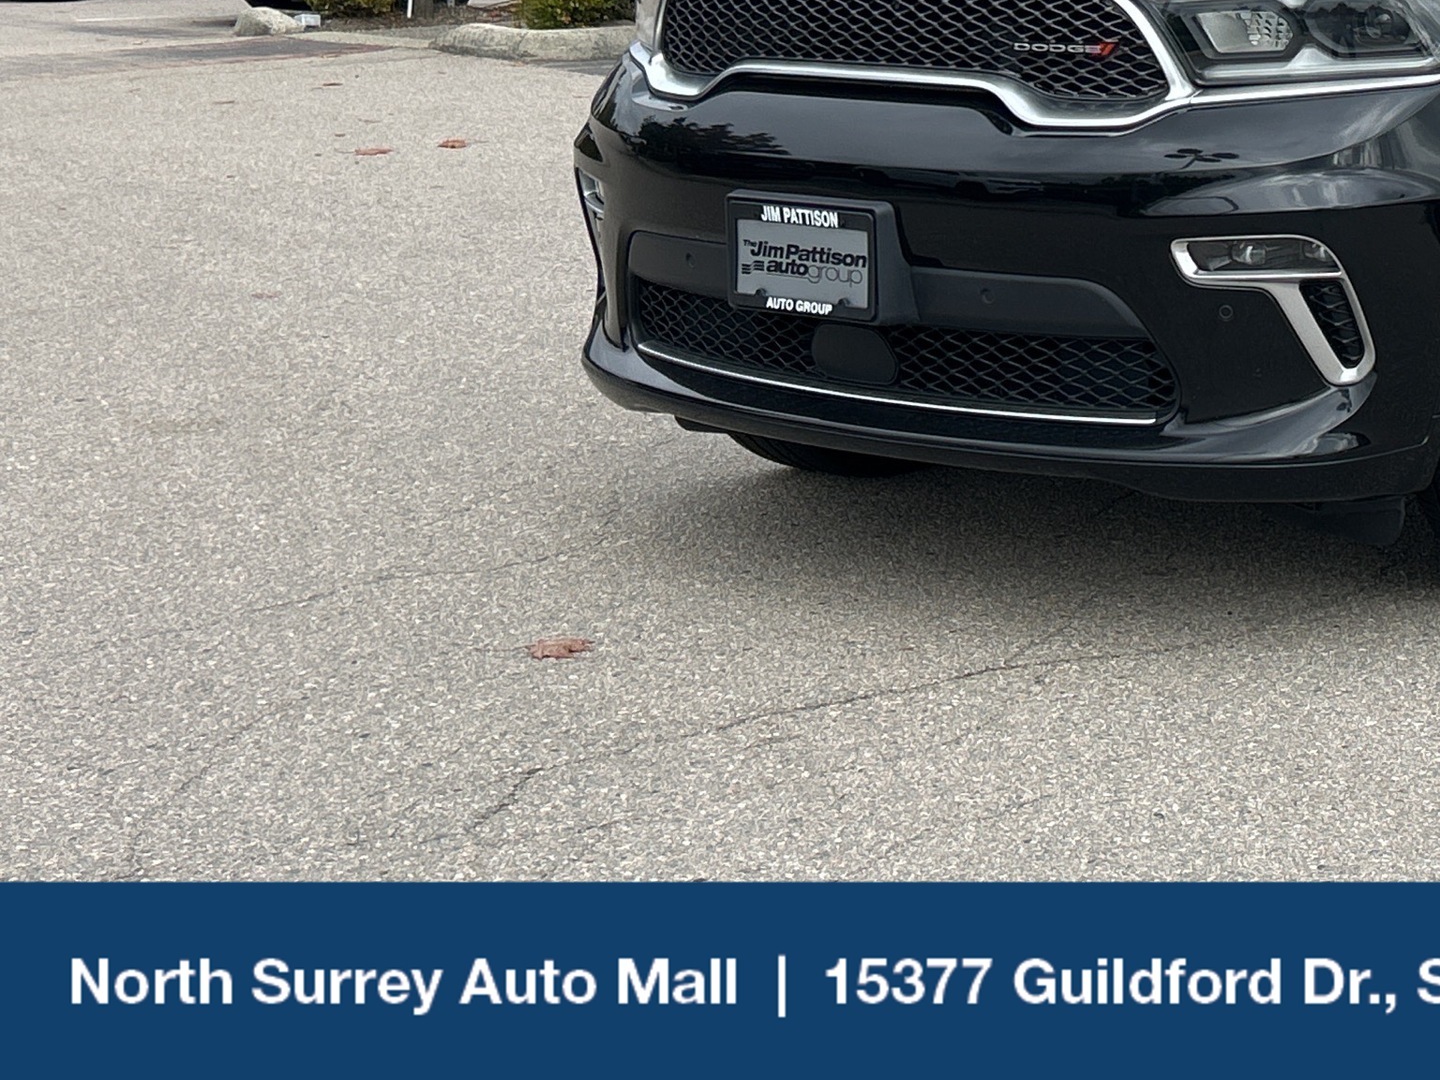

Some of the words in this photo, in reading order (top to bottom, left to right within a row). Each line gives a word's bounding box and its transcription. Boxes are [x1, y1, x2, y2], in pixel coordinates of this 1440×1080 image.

[1013, 42, 1101, 54] DODGE
[761, 205, 781, 223] JIM
[783, 207, 839, 229] PATTISON
[766, 297, 794, 311] AUTO
[795, 300, 833, 315] GROUP
